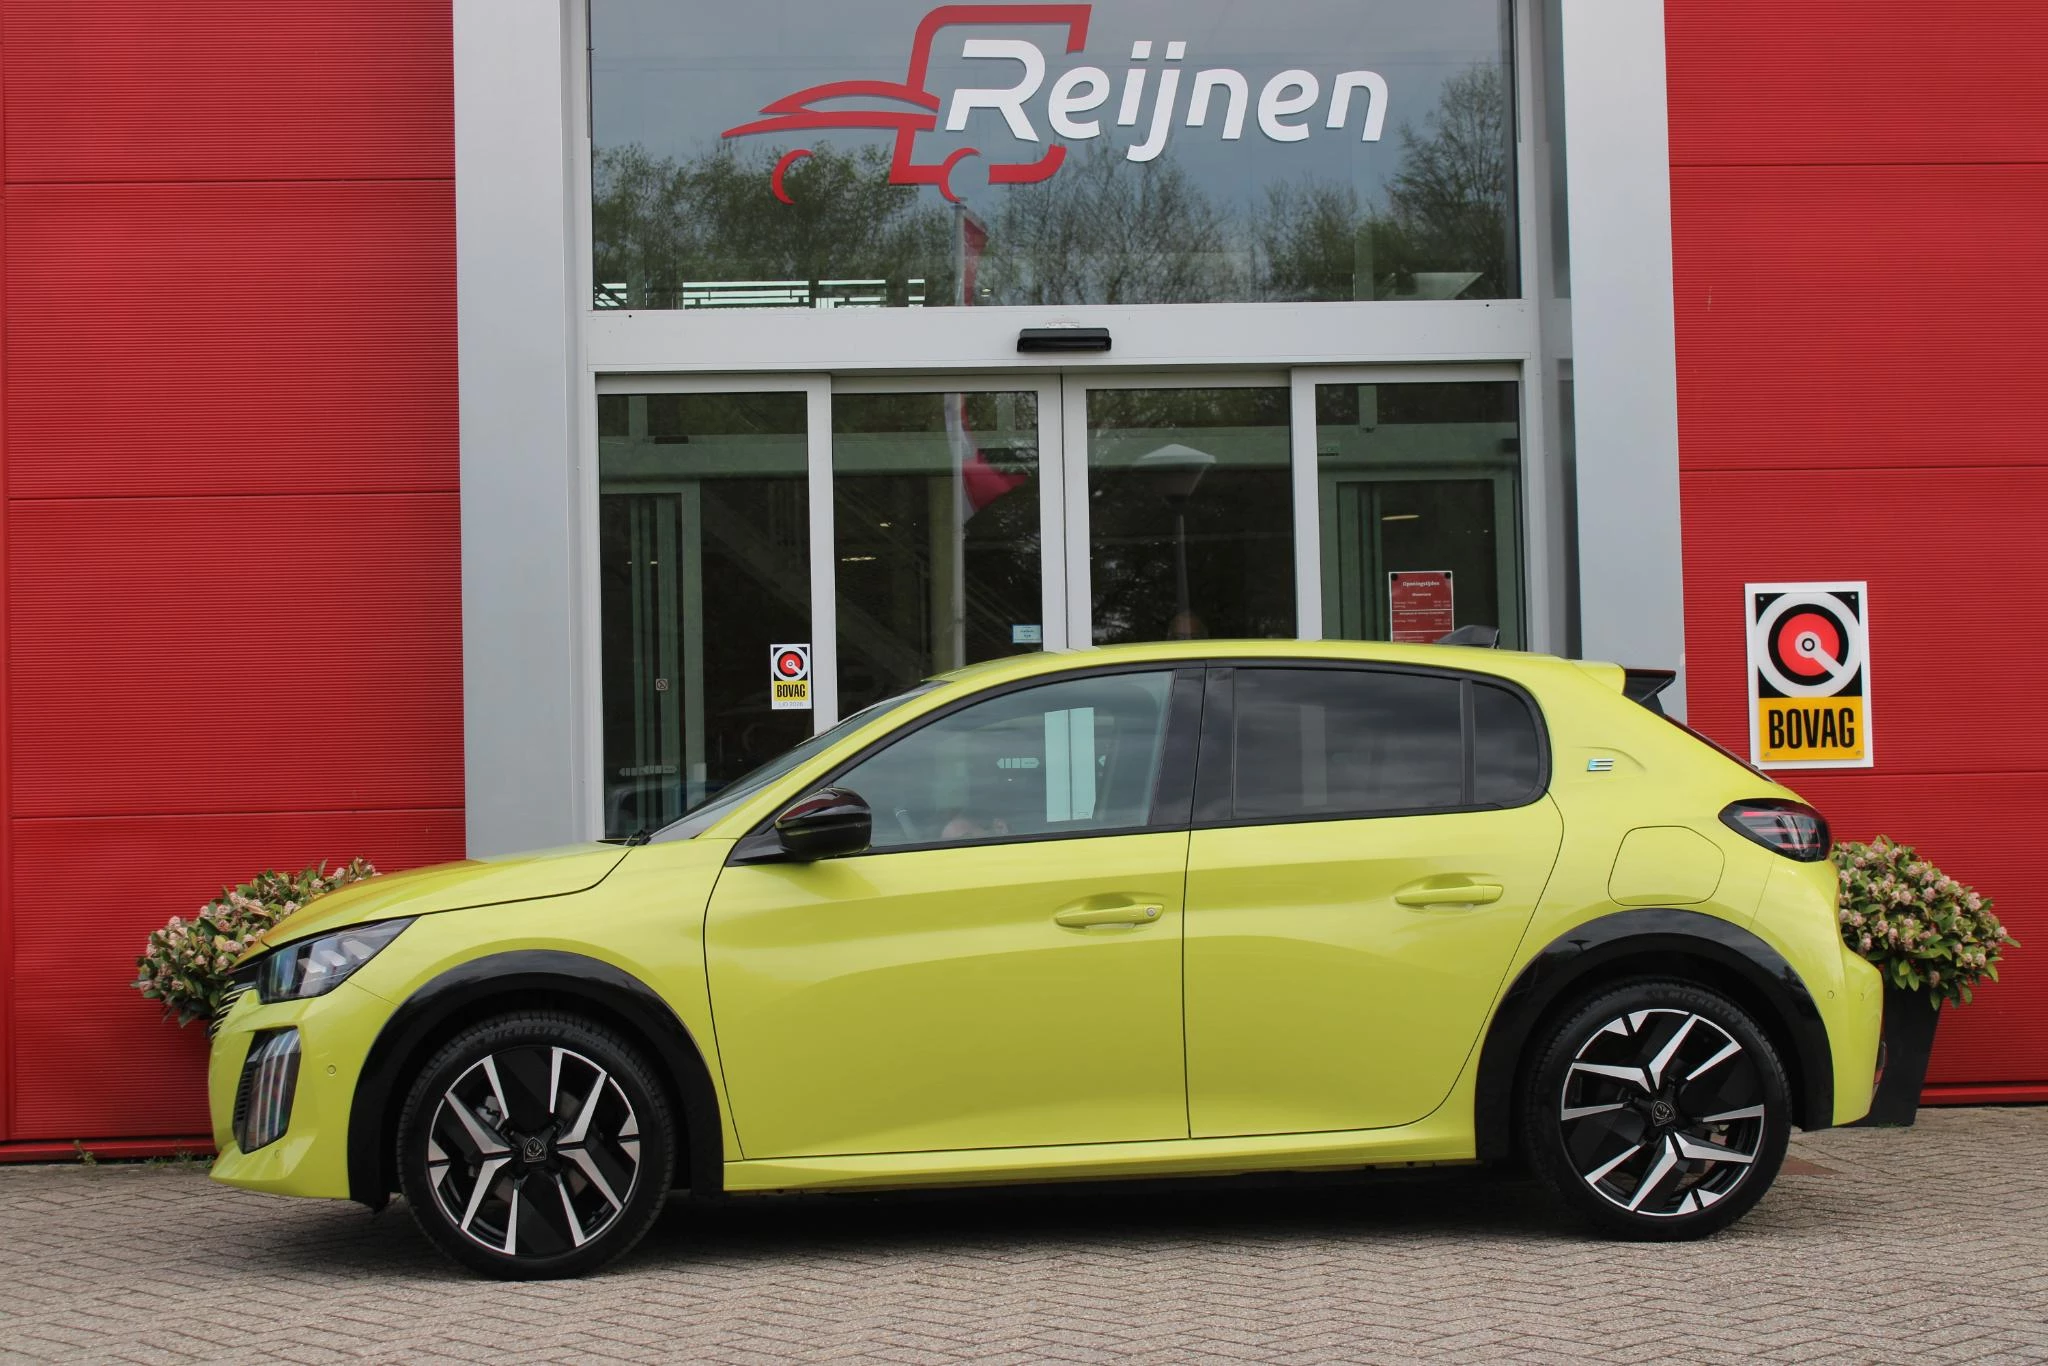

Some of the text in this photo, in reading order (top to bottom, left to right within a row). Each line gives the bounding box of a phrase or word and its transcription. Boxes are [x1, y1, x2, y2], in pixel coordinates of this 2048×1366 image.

[945, 39, 1389, 162] Reijnen
[777, 684, 806, 698] BOVAG
[1768, 707, 1855, 749] BOVAG
